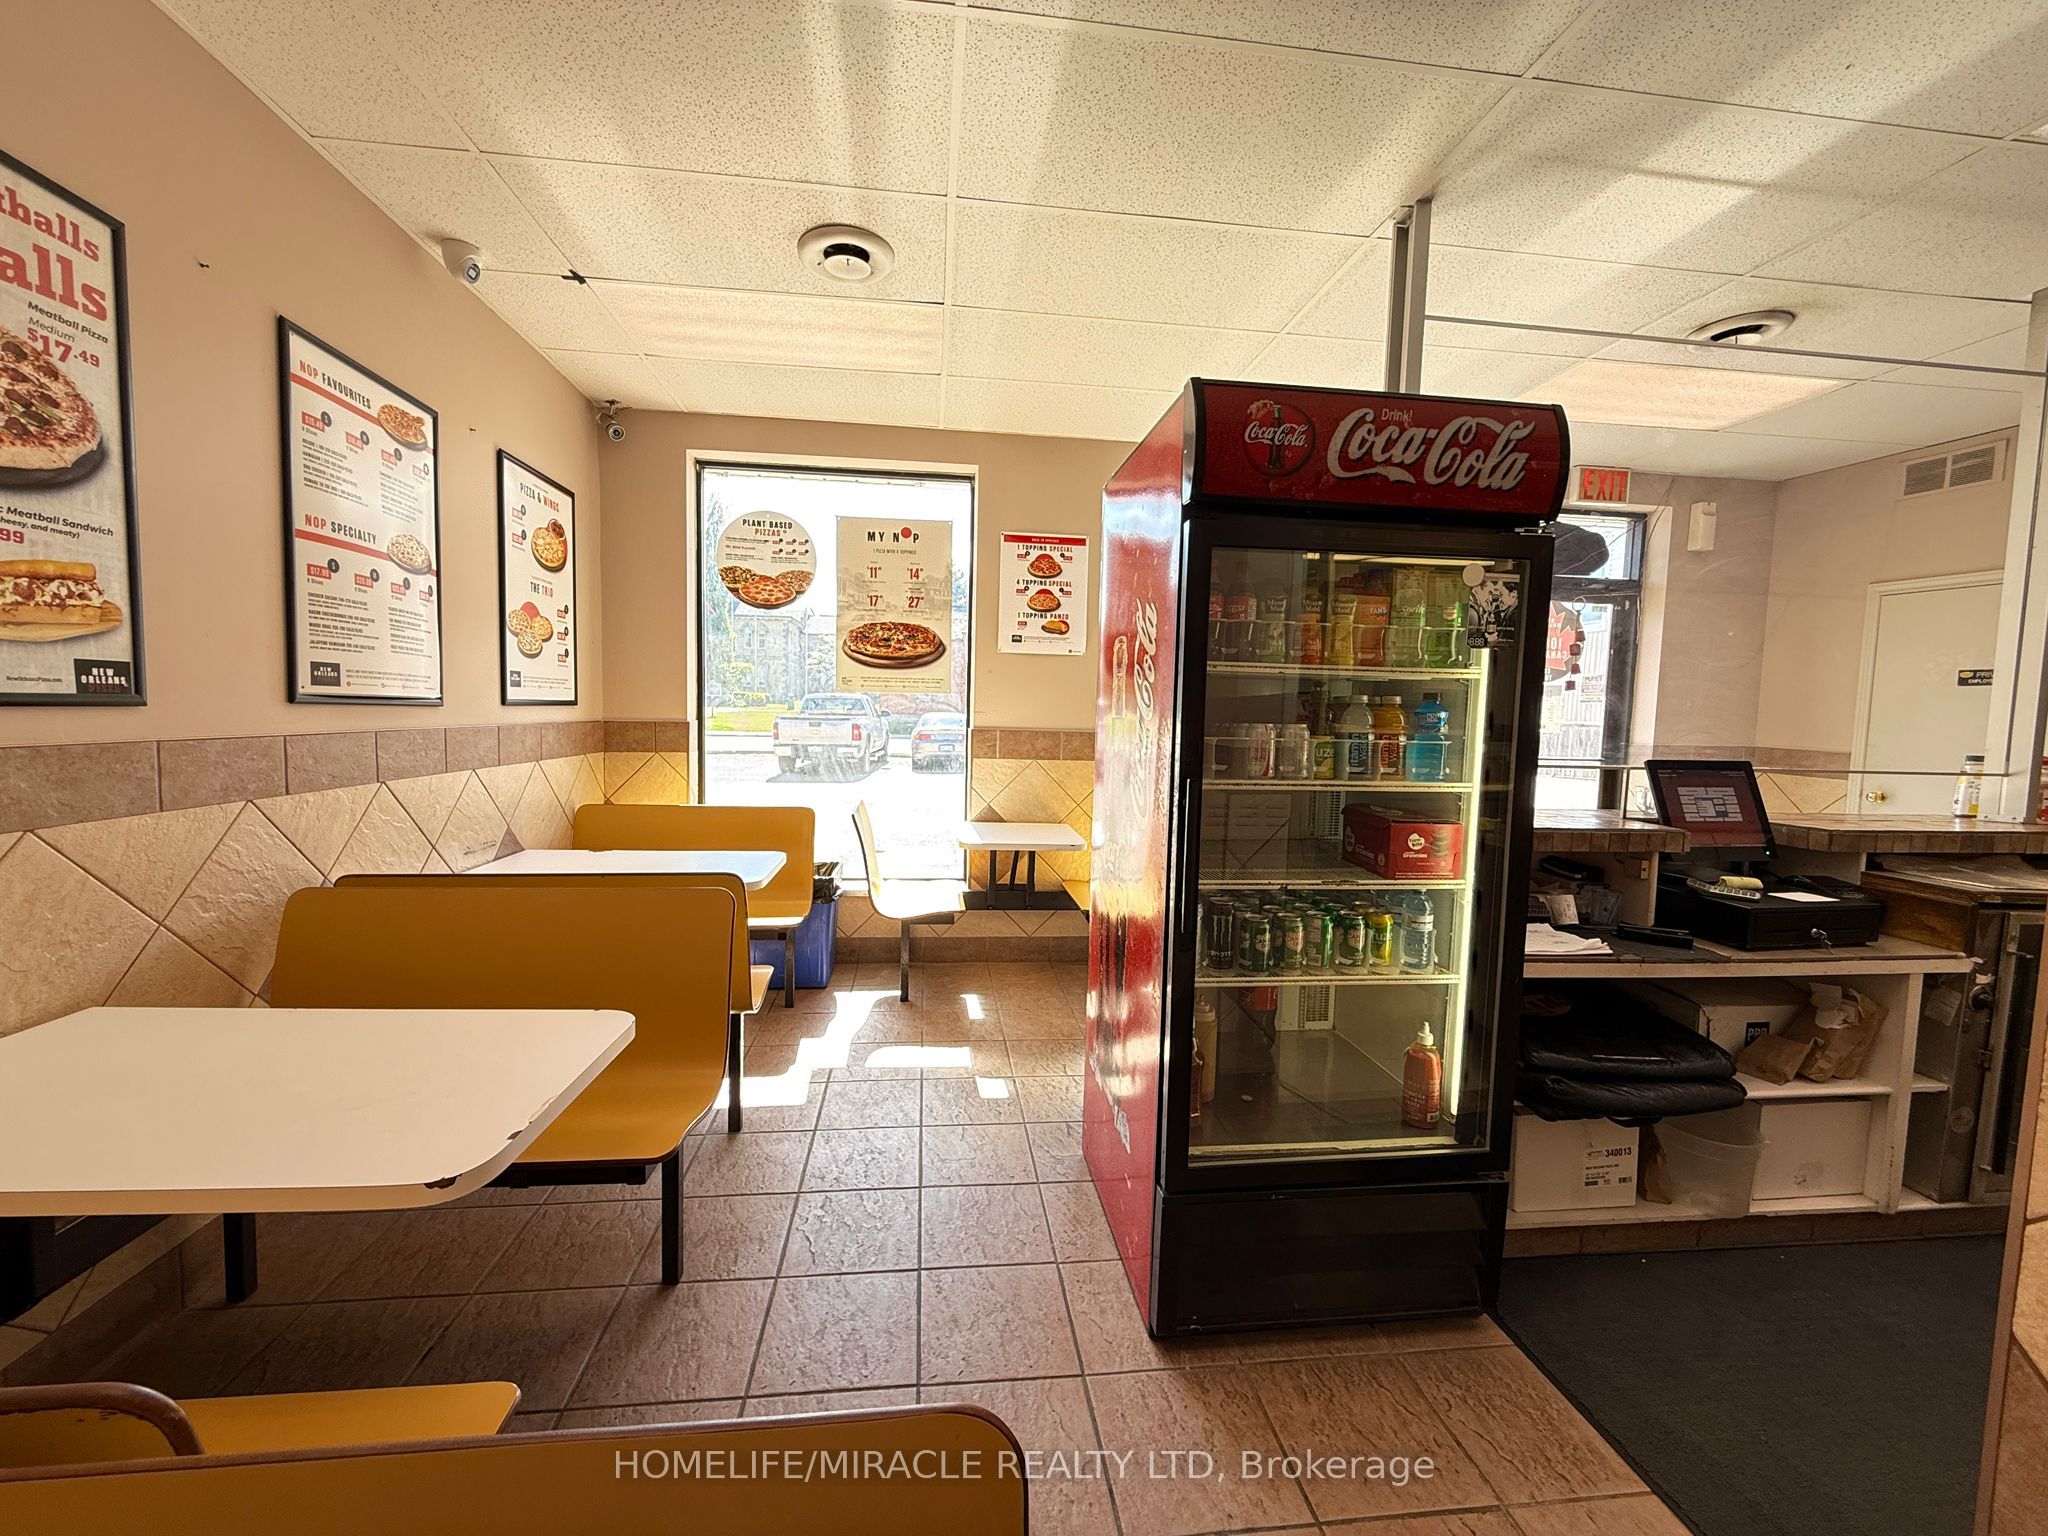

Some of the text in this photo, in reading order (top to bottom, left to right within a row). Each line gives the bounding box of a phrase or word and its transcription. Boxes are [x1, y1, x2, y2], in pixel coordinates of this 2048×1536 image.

[27, 301, 109, 344] Meatball Pizza
[28, 316, 76, 343] Medium
[27, 327, 100, 368] $17.49
[299, 360, 371, 410] NOP FAVOURITES
[1381, 408, 1413, 423] Drink!
[1244, 421, 1309, 447] Coca-Cola
[1327, 407, 1536, 491] Coca-Cola
[1584, 469, 1627, 501] EXIT
[520, 482, 536, 500] PIZZA
[537, 492, 542, 504] &
[543, 495, 559, 513] WINGS
[6, 505, 114, 537] Meatball Sandwich
[304, 513, 377, 545] NOP SPECIALTY
[742, 518, 793, 530] PLANT BASED
[31, 523, 49, 532] and
[50, 527, 80, 540] meaty)
[754, 528, 781, 537] PIZZAS
[867, 531, 886, 543] MY
[1022, 544, 1048, 552] TOPPING
[530, 581, 554, 598] THE TRIO
[81, 675, 127, 685] ORLEANS
[91, 668, 114, 676] NEW
[1315, 748, 1335, 758] uze
[1605, 1146, 1632, 1158] 340013
